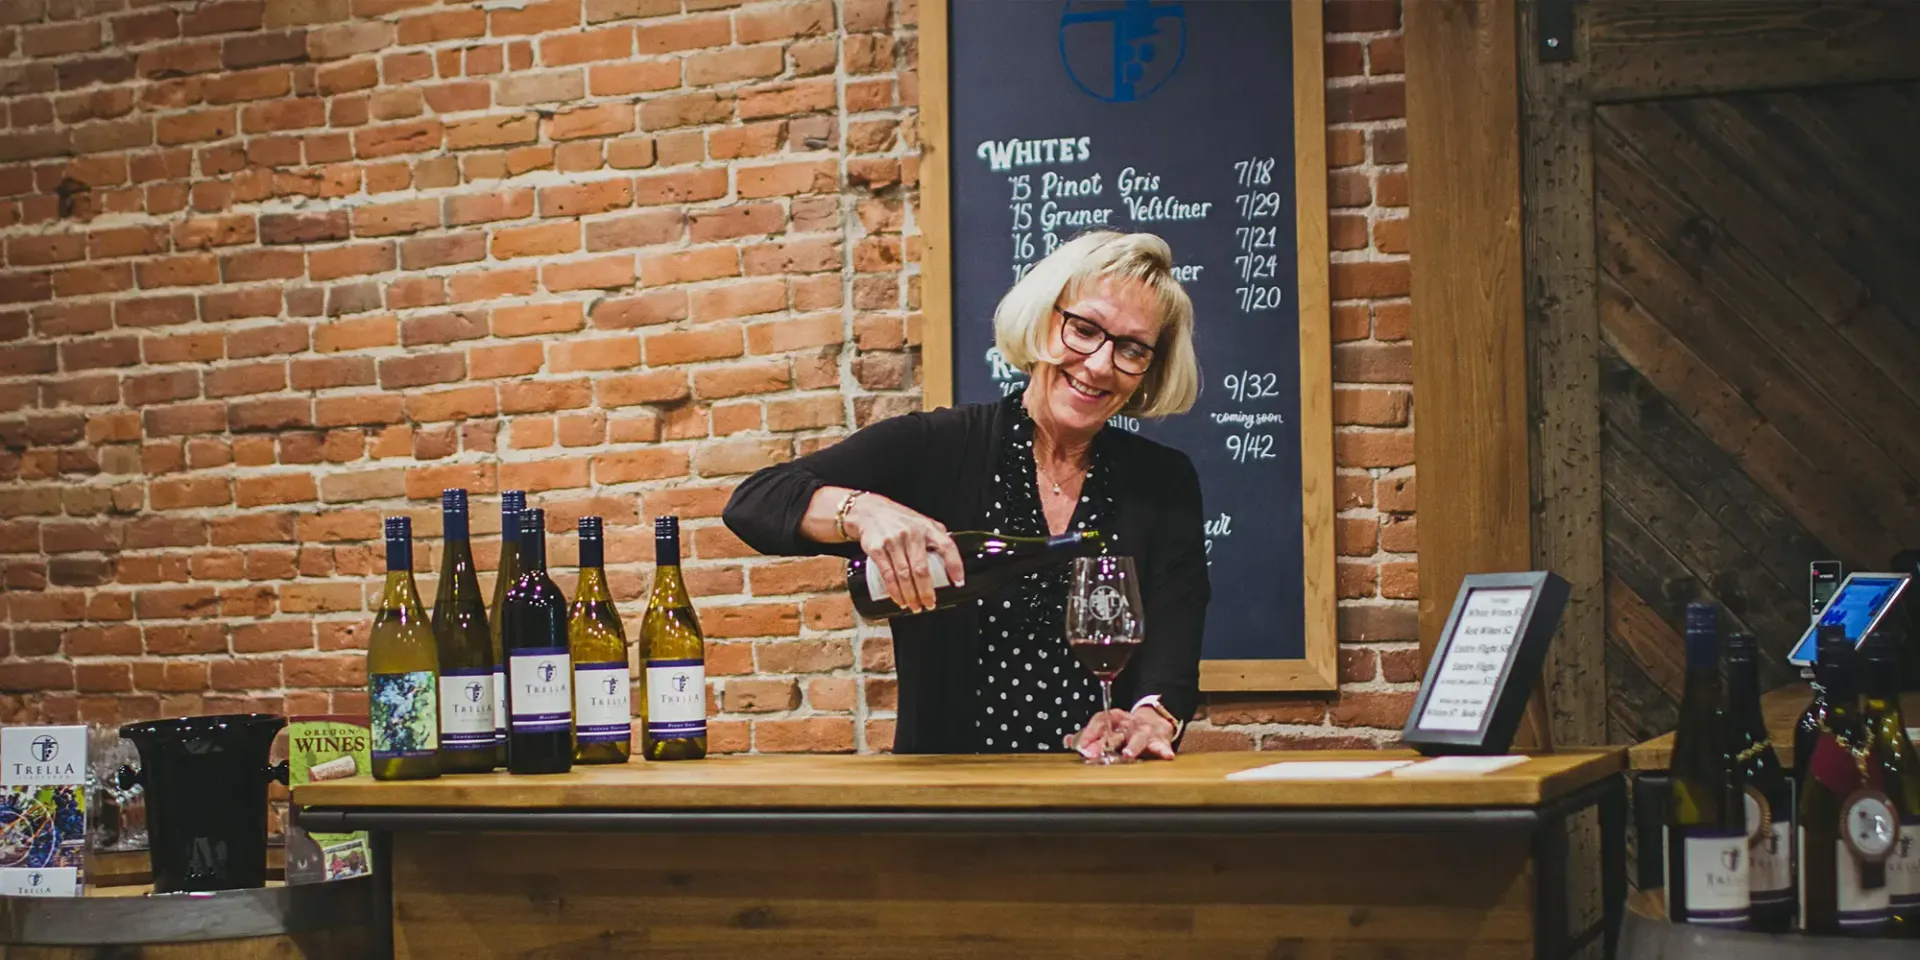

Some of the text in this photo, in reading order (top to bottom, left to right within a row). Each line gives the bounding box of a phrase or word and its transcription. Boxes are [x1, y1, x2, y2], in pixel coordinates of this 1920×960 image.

[977, 137, 1091, 171] WHITES
[1041, 171, 1102, 200] Pinot
[1118, 167, 1160, 197] Gris
[1234, 156, 1275, 187] 7/18
[1040, 201, 1113, 232] Gruner
[1124, 196, 1212, 222] Veltliner
[1235, 190, 1280, 221] 7/29
[1236, 226, 1277, 253] 7/21
[1234, 252, 1277, 283] 7/24
[1235, 284, 1281, 313] 7/20
[1224, 370, 1279, 402] 9/32
[1255, 413, 1284, 425] soon
[1226, 432, 1276, 463] 9/42
[294, 736, 366, 753] WINES
[304, 728, 355, 737] OREGON
[13, 763, 75, 775] TRELLA
